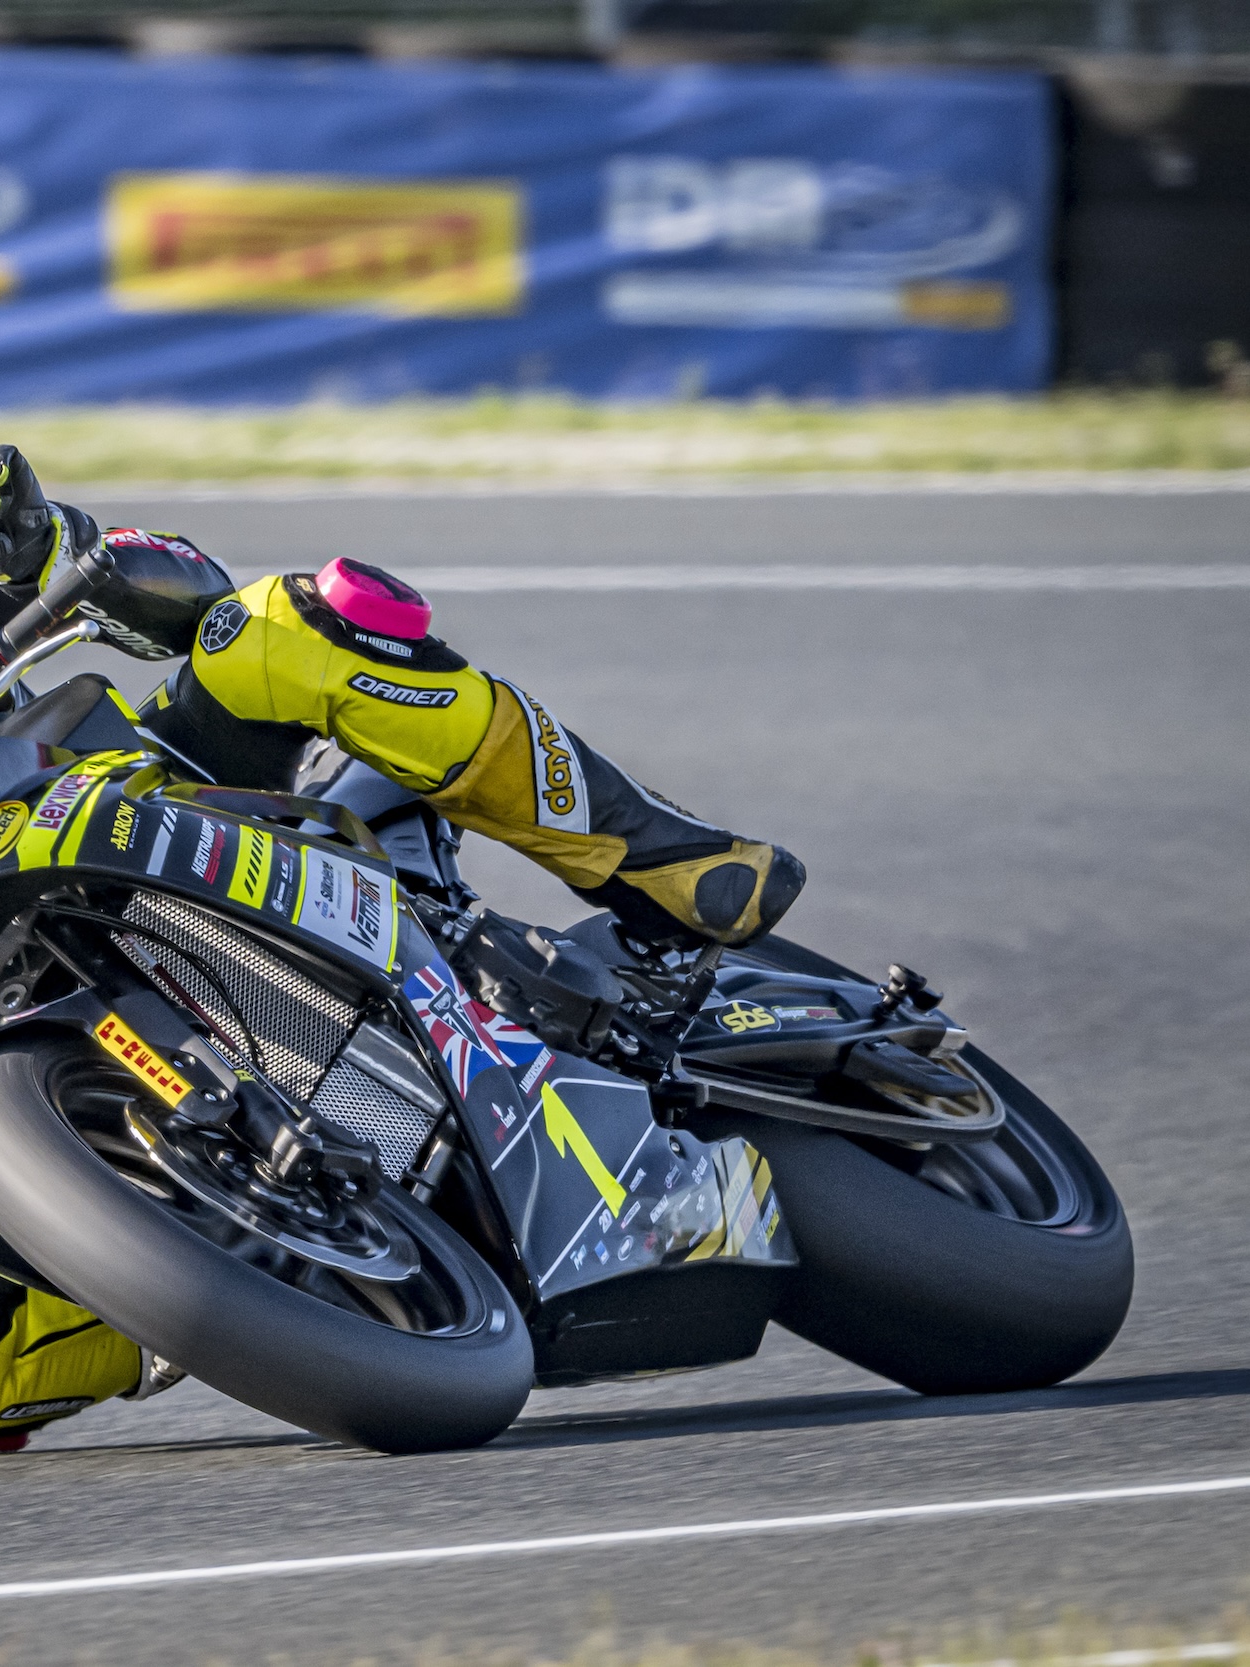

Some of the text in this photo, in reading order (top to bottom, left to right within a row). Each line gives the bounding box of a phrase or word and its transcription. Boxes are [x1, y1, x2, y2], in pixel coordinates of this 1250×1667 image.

[352, 675, 457, 705] DAMEN
[525, 692, 576, 816] dayton
[110, 800, 136, 852] ARROW
[191, 818, 216, 878] HERTRAMPF
[722, 1001, 776, 1034] sbs
[98, 1021, 184, 1095] PIRELLI
[540, 1081, 627, 1219] 1
